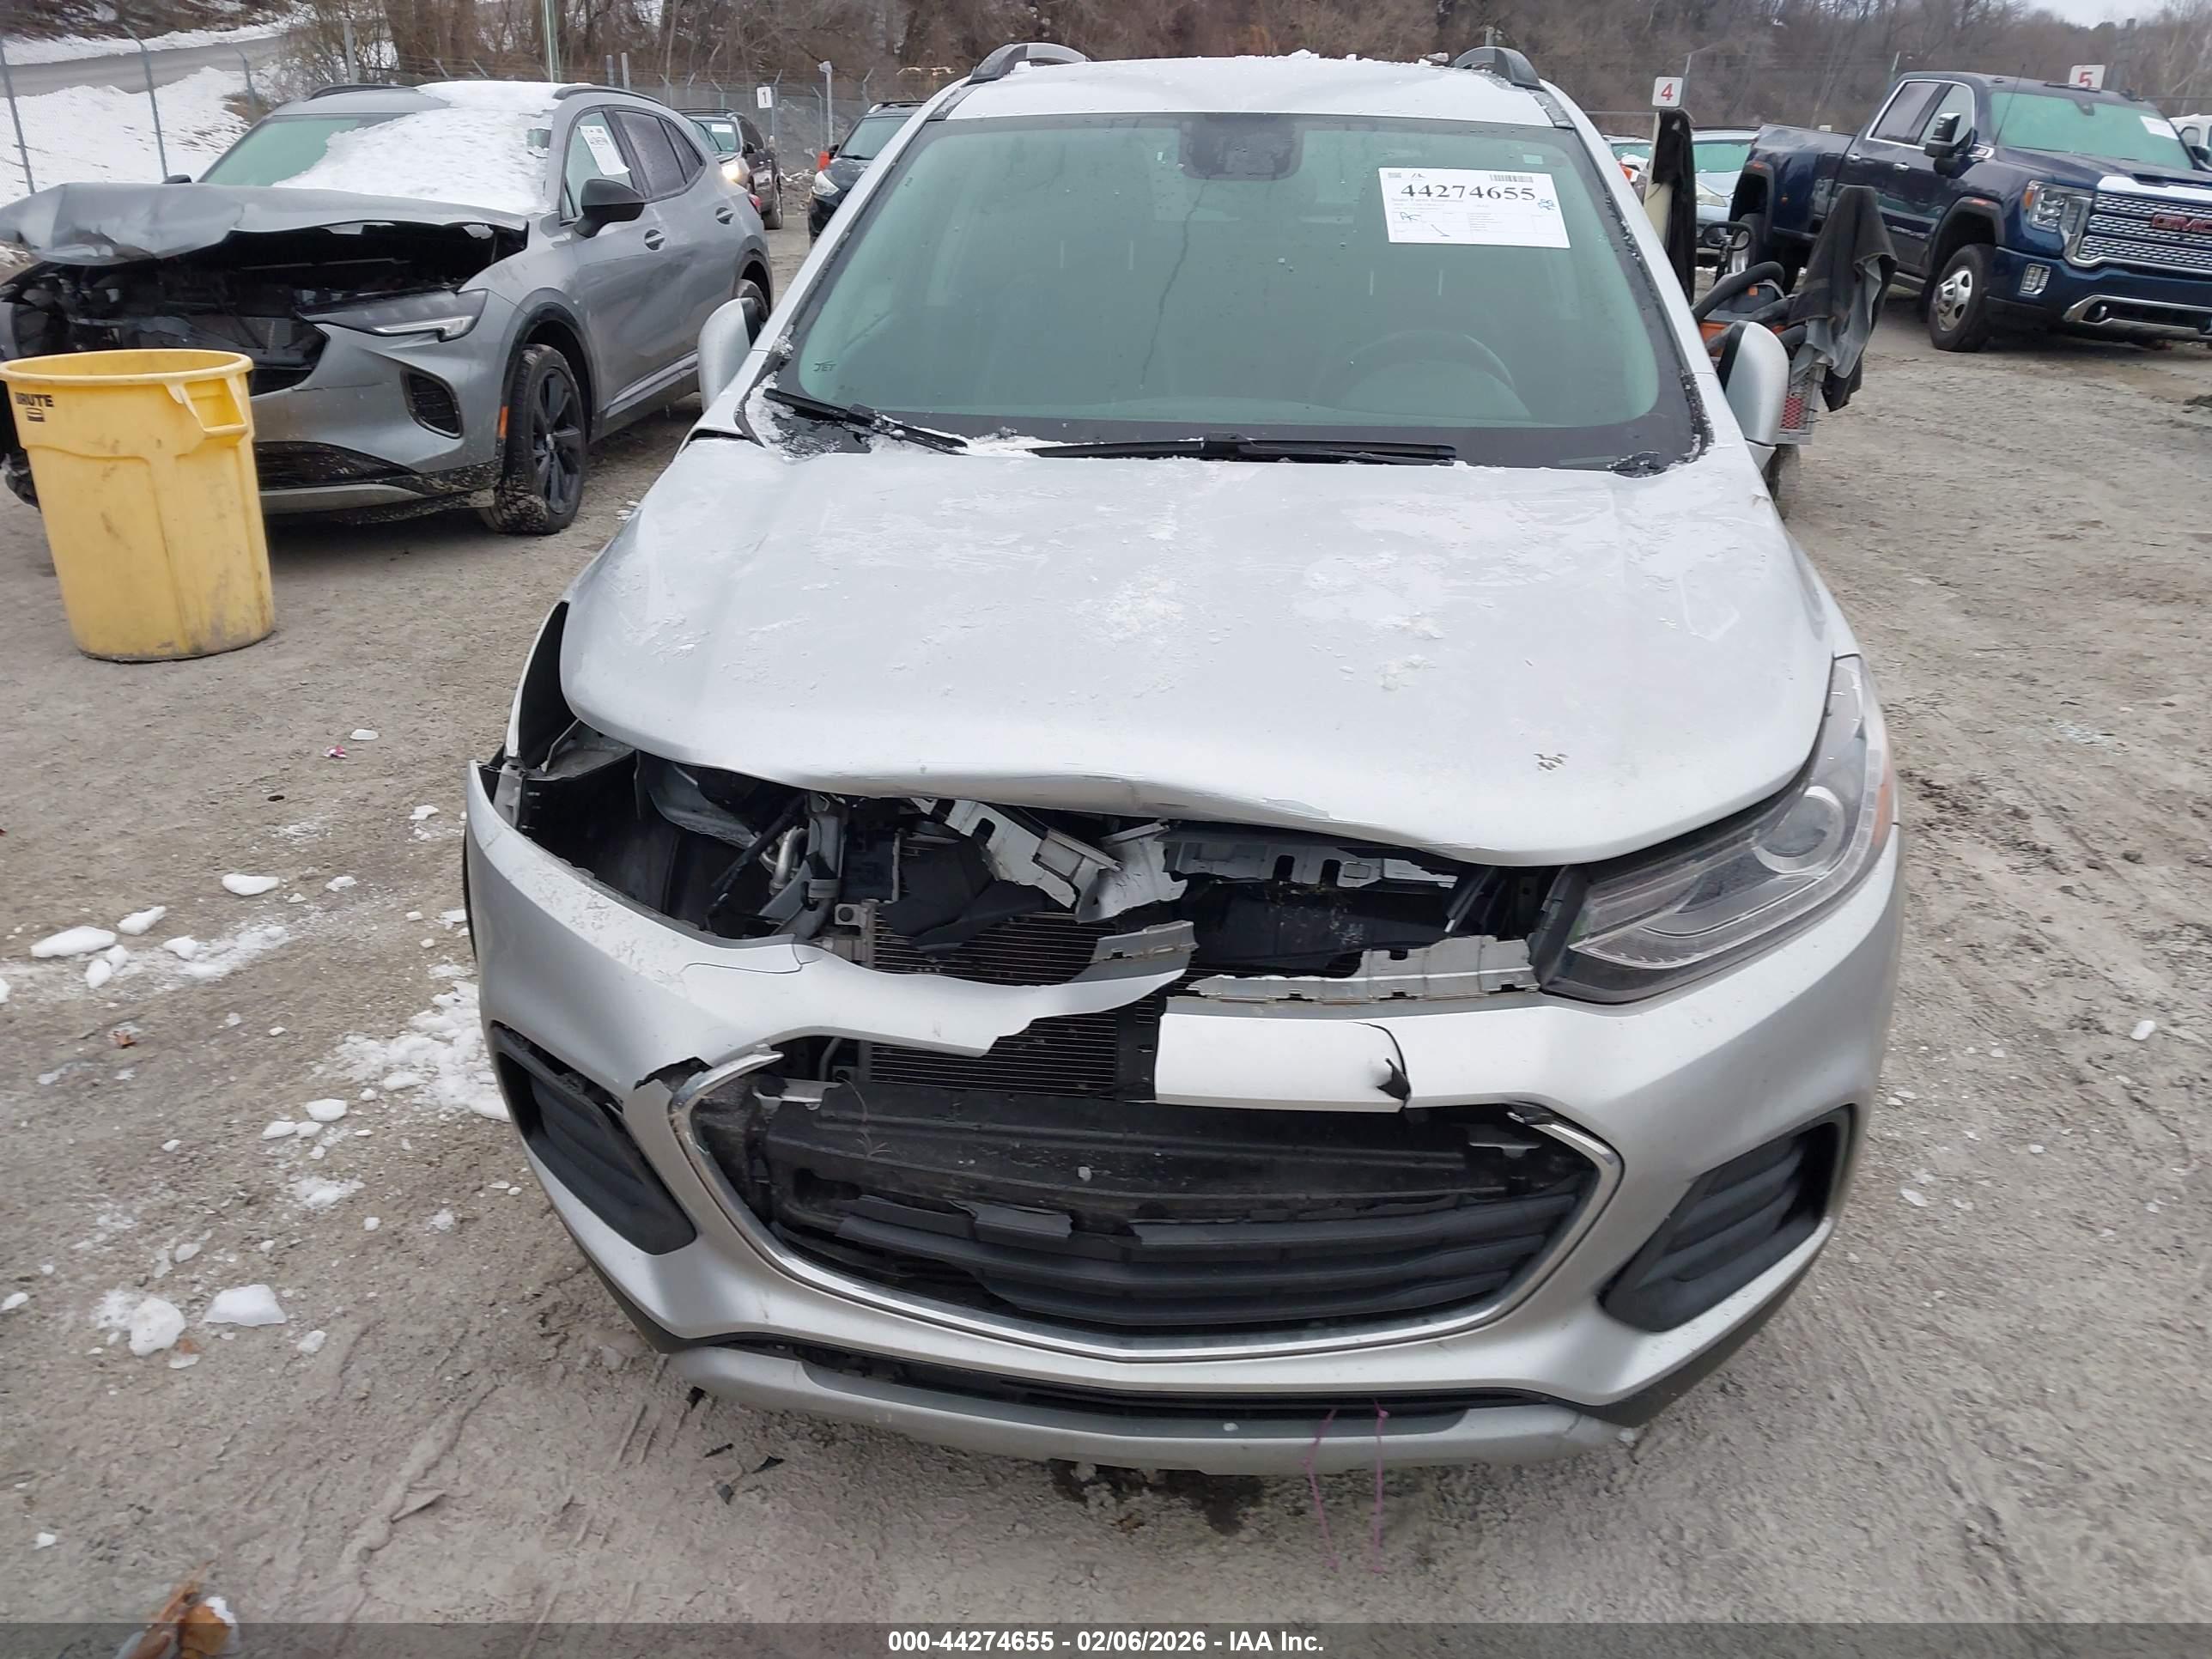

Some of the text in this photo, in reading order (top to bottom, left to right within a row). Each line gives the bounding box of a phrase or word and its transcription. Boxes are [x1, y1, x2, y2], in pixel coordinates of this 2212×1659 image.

[2078, 71, 2094, 88] 5
[1661, 82, 1674, 101] 4
[1401, 184, 1535, 201] 44274655
